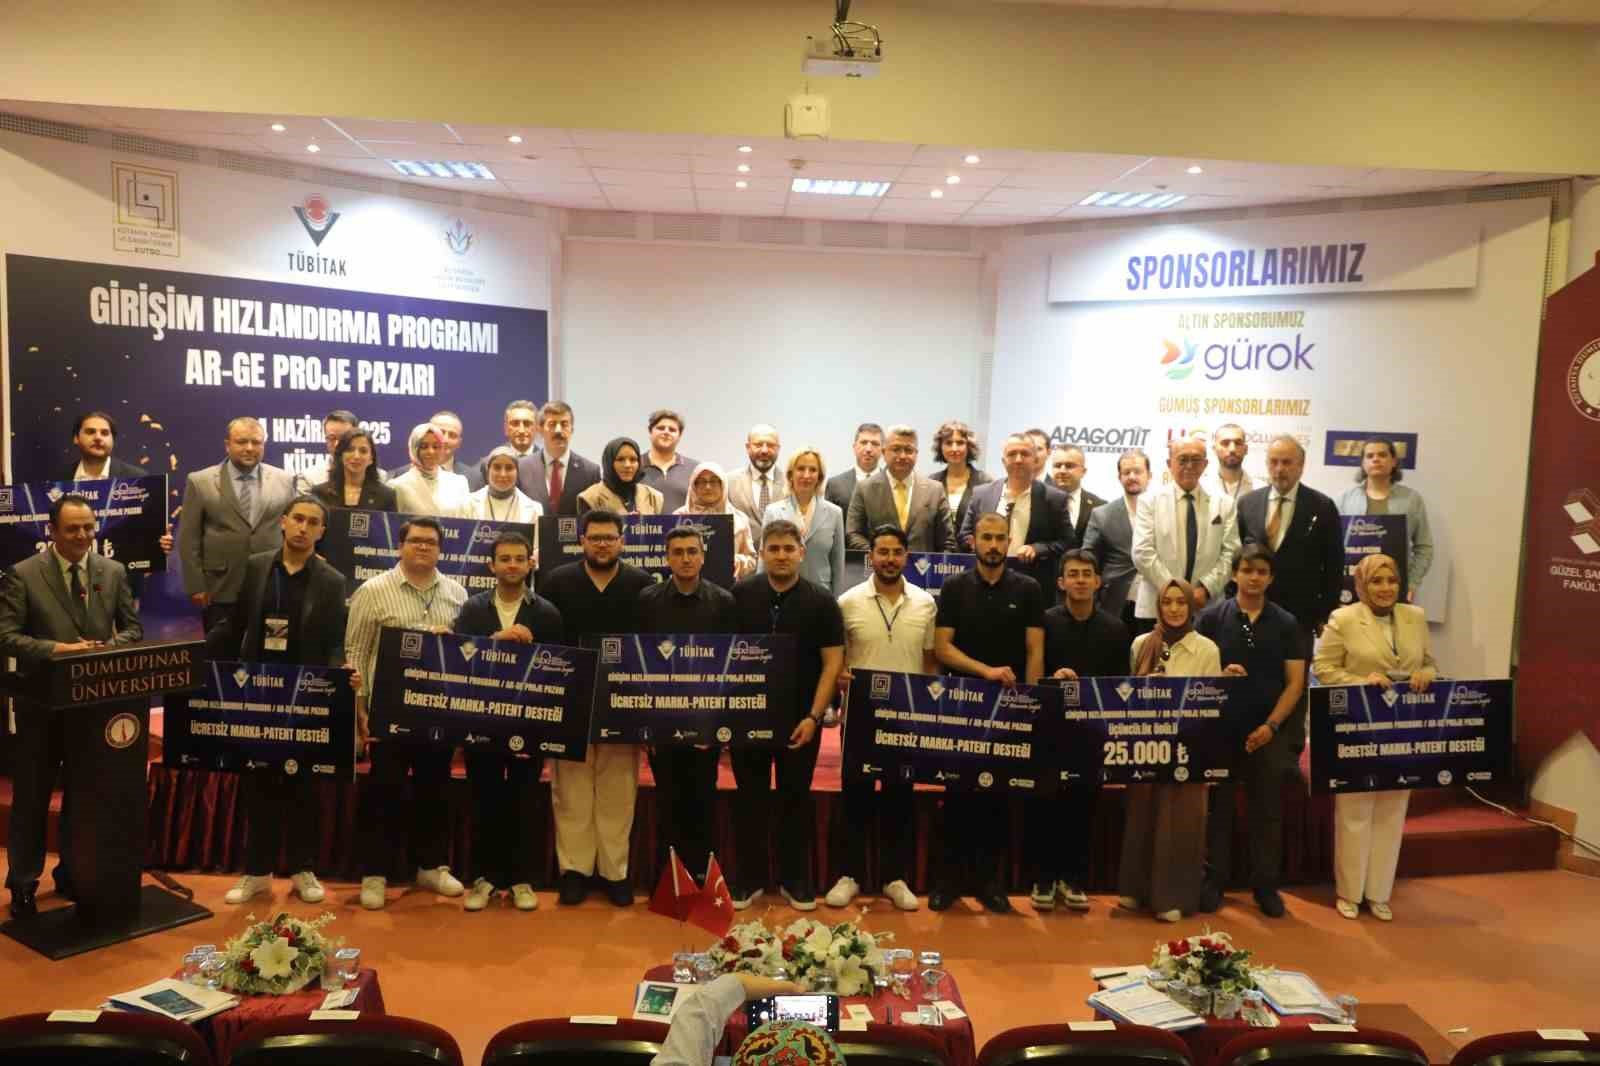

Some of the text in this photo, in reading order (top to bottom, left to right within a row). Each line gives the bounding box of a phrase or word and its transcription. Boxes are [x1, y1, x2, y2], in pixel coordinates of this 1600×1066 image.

[288, 250, 348, 276] TÜBİTAK
[1127, 242, 1367, 291] SPONSORLARIMIZ
[90, 280, 499, 354] GİRİŞİM HIZLANDIRMA PROGRAMI
[1214, 311, 1305, 329] SPONSORUMUZ
[1204, 334, 1316, 380] gürok
[185, 349, 435, 396] AR-GE PROJE PAZARI
[1204, 397, 1312, 416] SPONSORLARIMIZ
[272, 414, 327, 443] HAZİR
[469, 574, 499, 588] DESTE
[72, 650, 191, 679] DUMLUPINAR
[72, 668, 191, 701] ÜNİVERSİTESİ
[404, 689, 448, 710] ÜCRETSİZ
[610, 693, 653, 709] ÜCRETSİZ
[190, 720, 228, 736] ÜCRETSİZ
[875, 729, 918, 748] ÜCRETSİZ
[1104, 741, 1171, 765] 25.000
